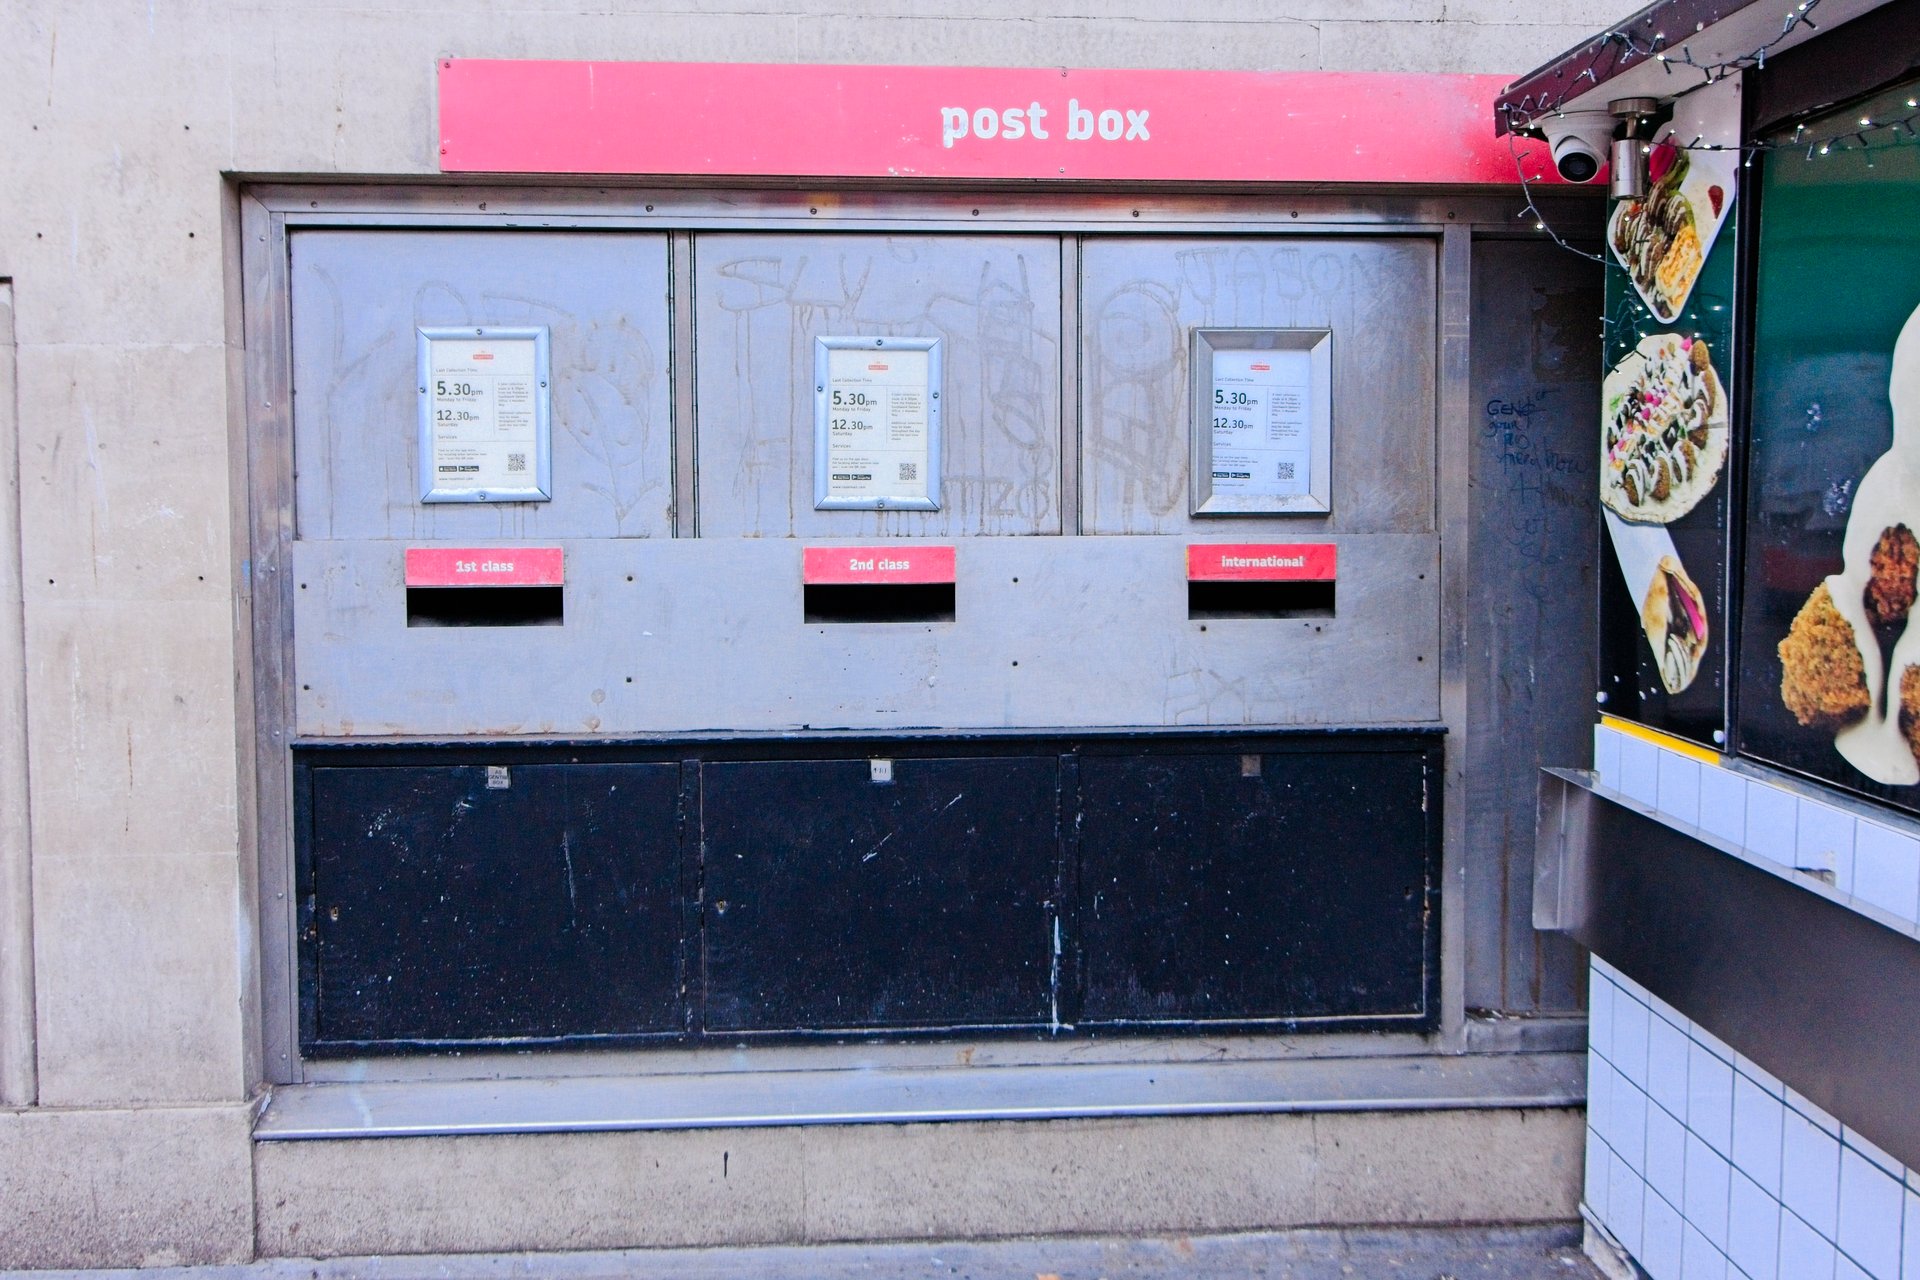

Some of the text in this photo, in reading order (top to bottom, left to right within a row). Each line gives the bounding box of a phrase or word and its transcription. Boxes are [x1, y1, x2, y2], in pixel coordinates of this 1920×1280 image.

[941, 98, 1150, 149] post box
[437, 381, 483, 397] 5.30pm
[832, 391, 878, 407] 5.30pm
[1215, 390, 1259, 406] 5.30pm
[437, 410, 480, 422] 12.30pm
[832, 419, 874, 431] 12.30pm
[1213, 418, 1254, 429] 12.30pm
[455, 560, 514, 573] 1st class
[849, 558, 910, 571] 2nd class
[1221, 555, 1304, 568] international
